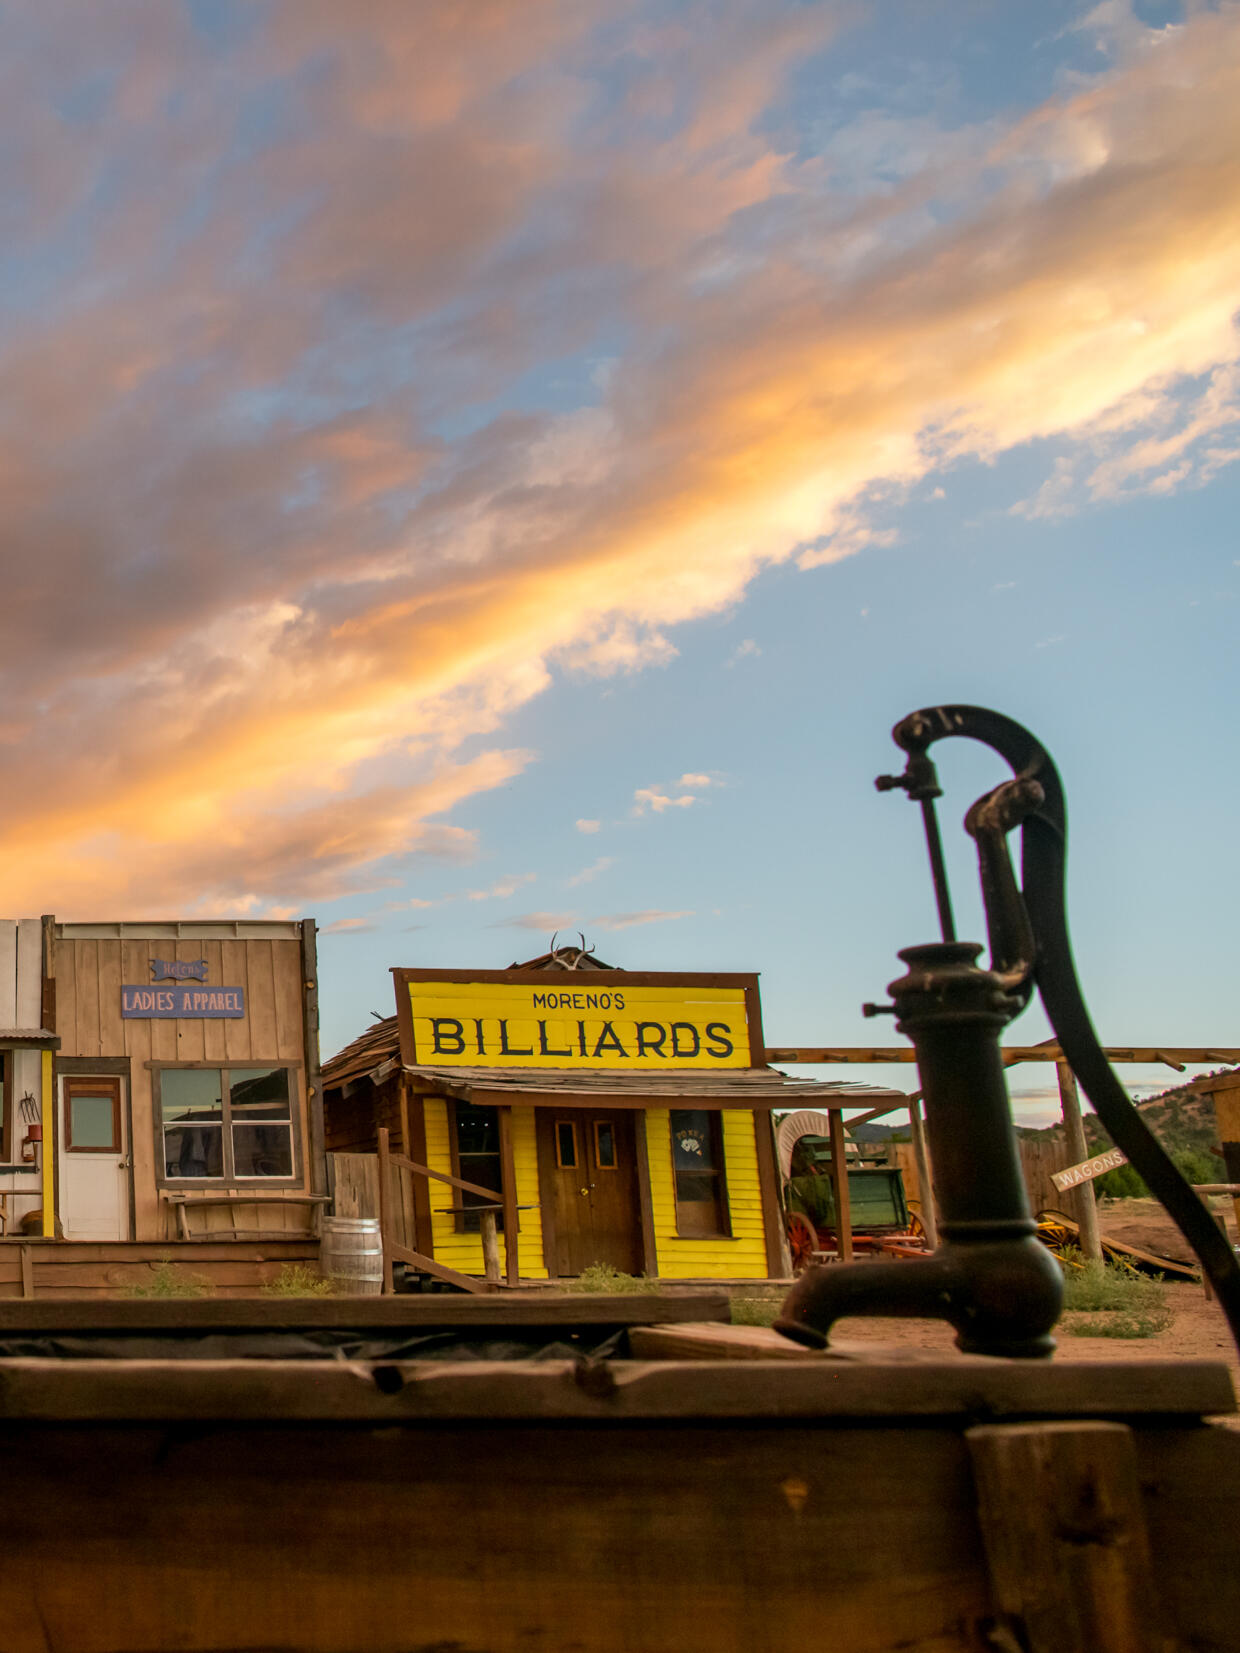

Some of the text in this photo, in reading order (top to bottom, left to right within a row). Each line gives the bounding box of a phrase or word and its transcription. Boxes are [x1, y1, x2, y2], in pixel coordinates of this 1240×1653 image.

[122, 991, 242, 1012] LADIES APPAREL
[532, 992, 626, 1011] MORENO'S
[428, 1017, 736, 1059] BILLIARDS
[1059, 1151, 1124, 1187] WAGONS
